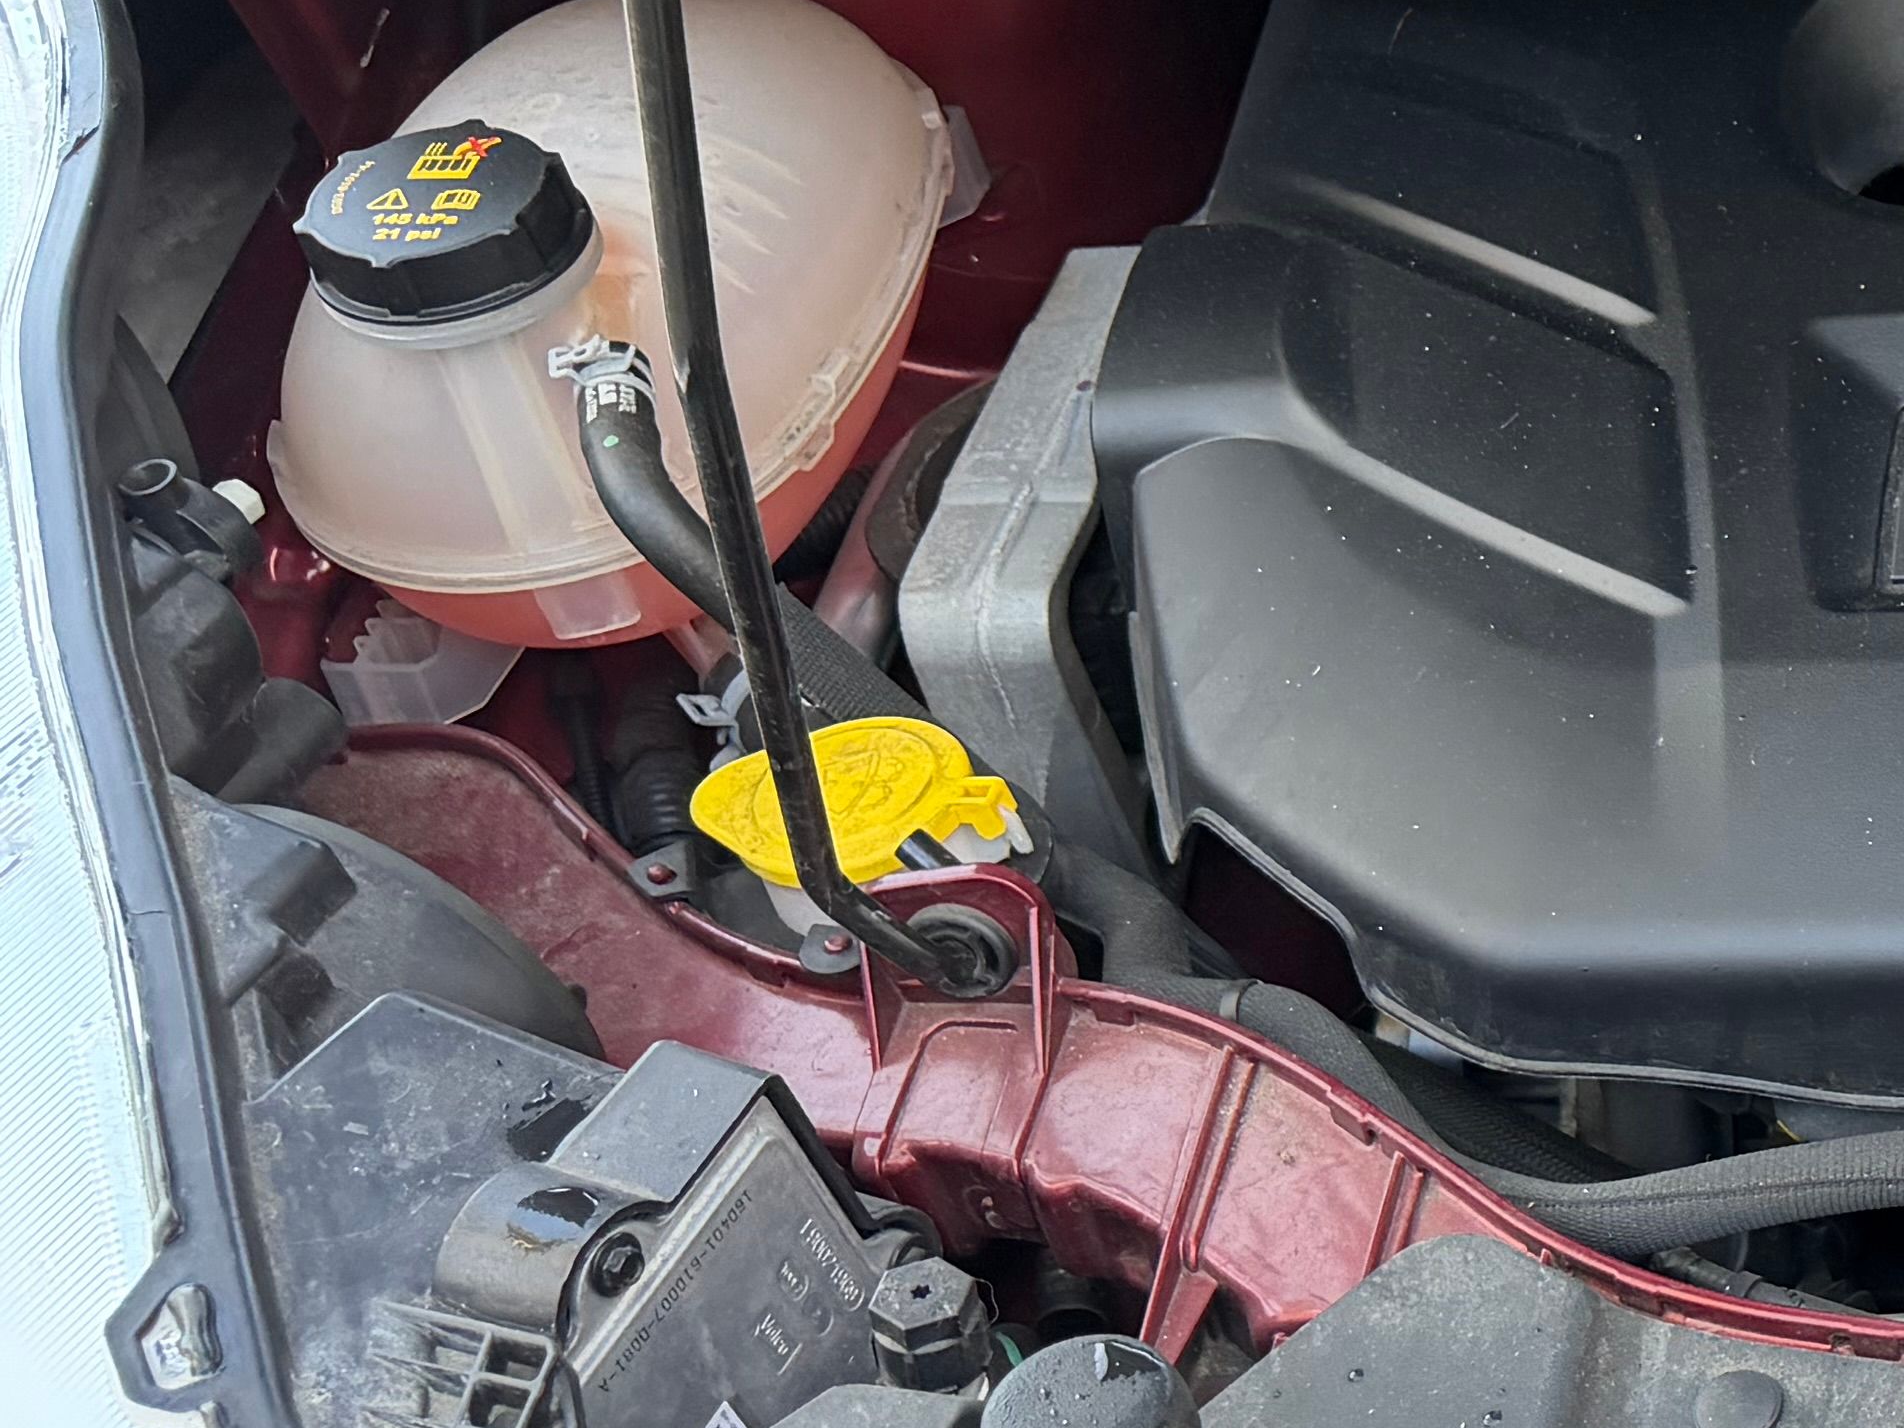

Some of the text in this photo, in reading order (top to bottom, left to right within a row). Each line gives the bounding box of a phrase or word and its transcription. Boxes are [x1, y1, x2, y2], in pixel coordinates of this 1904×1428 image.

[373, 213, 459, 226] 145 kPa
[372, 227, 443, 241] 21 psi
